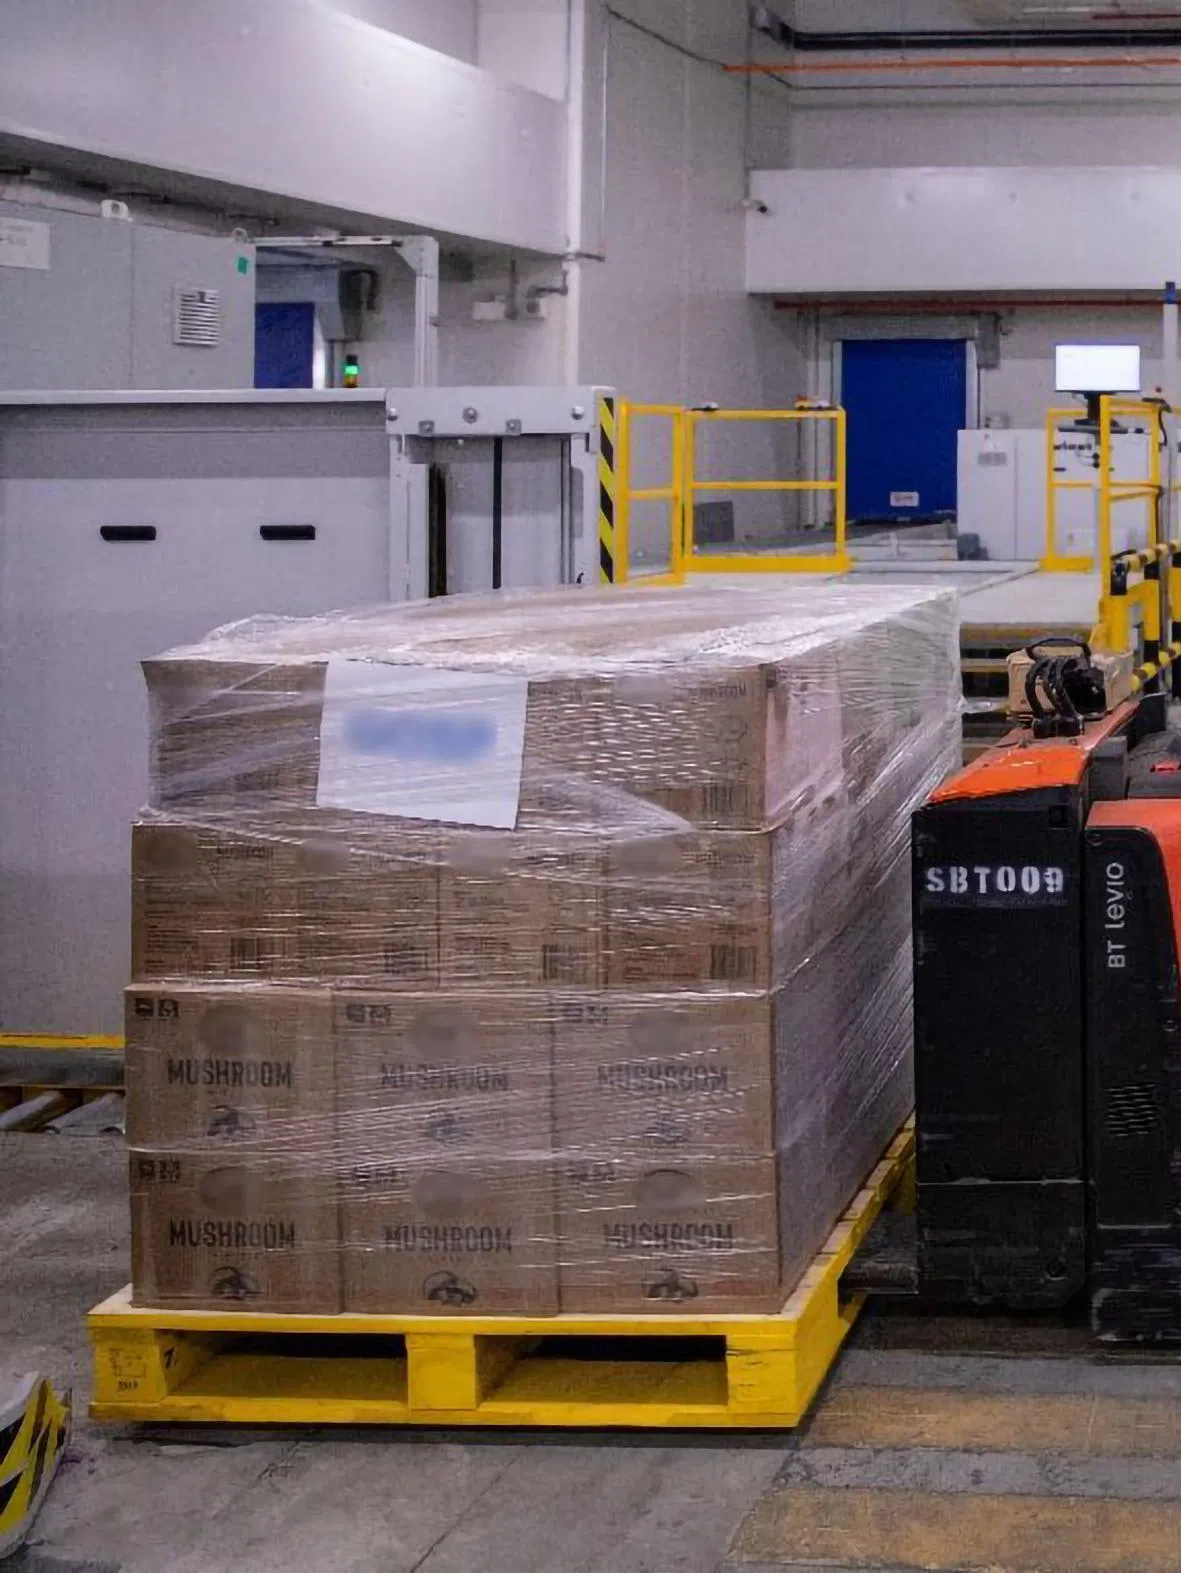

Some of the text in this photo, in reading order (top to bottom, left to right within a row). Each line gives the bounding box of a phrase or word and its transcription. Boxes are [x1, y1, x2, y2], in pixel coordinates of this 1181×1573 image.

[925, 865, 1065, 895] SBT009
[1106, 940, 1127, 969] BT
[167, 1058, 293, 1089] MUSHROOM
[169, 1219, 296, 1249] MUSHROOM
[383, 1224, 513, 1254] MUSHROOM
